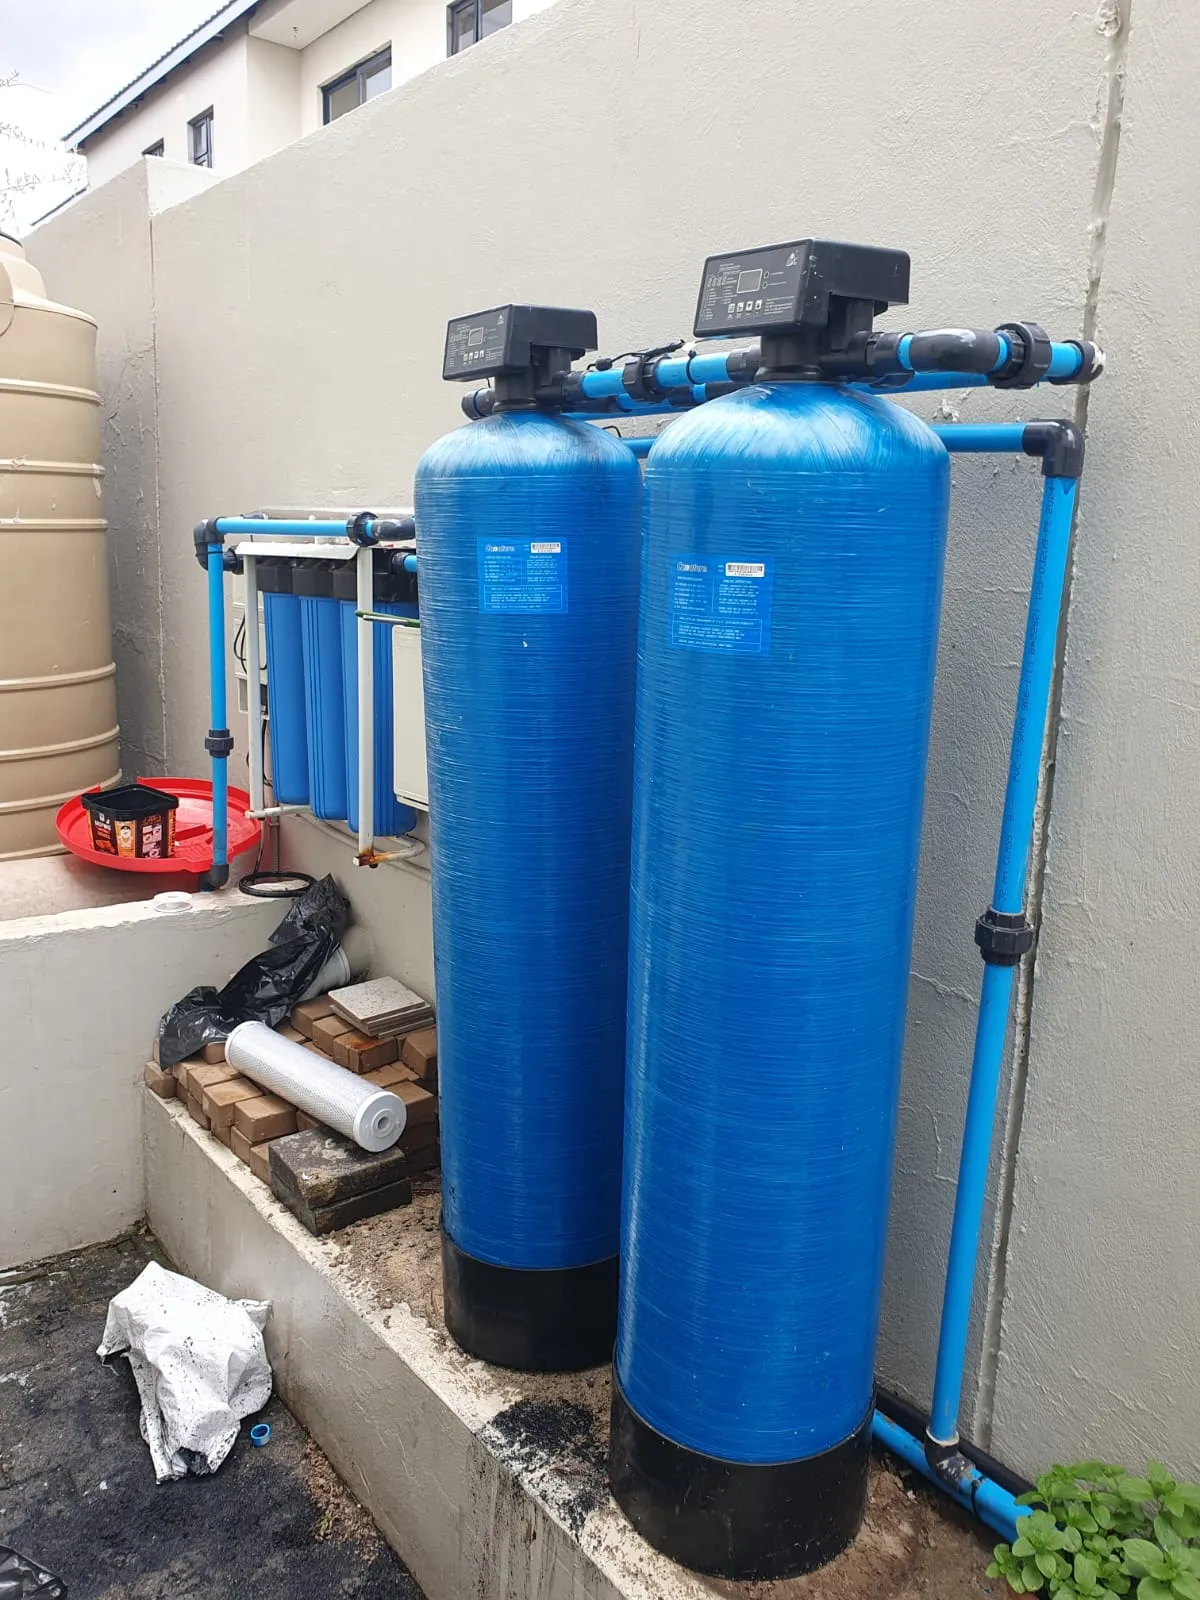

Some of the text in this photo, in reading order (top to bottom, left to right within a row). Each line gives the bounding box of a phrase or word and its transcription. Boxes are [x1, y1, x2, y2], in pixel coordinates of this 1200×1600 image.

[1017, 716, 1026, 744] SANS
[1012, 749, 1023, 782] PVC-U
[1002, 834, 1013, 865] CLASS
